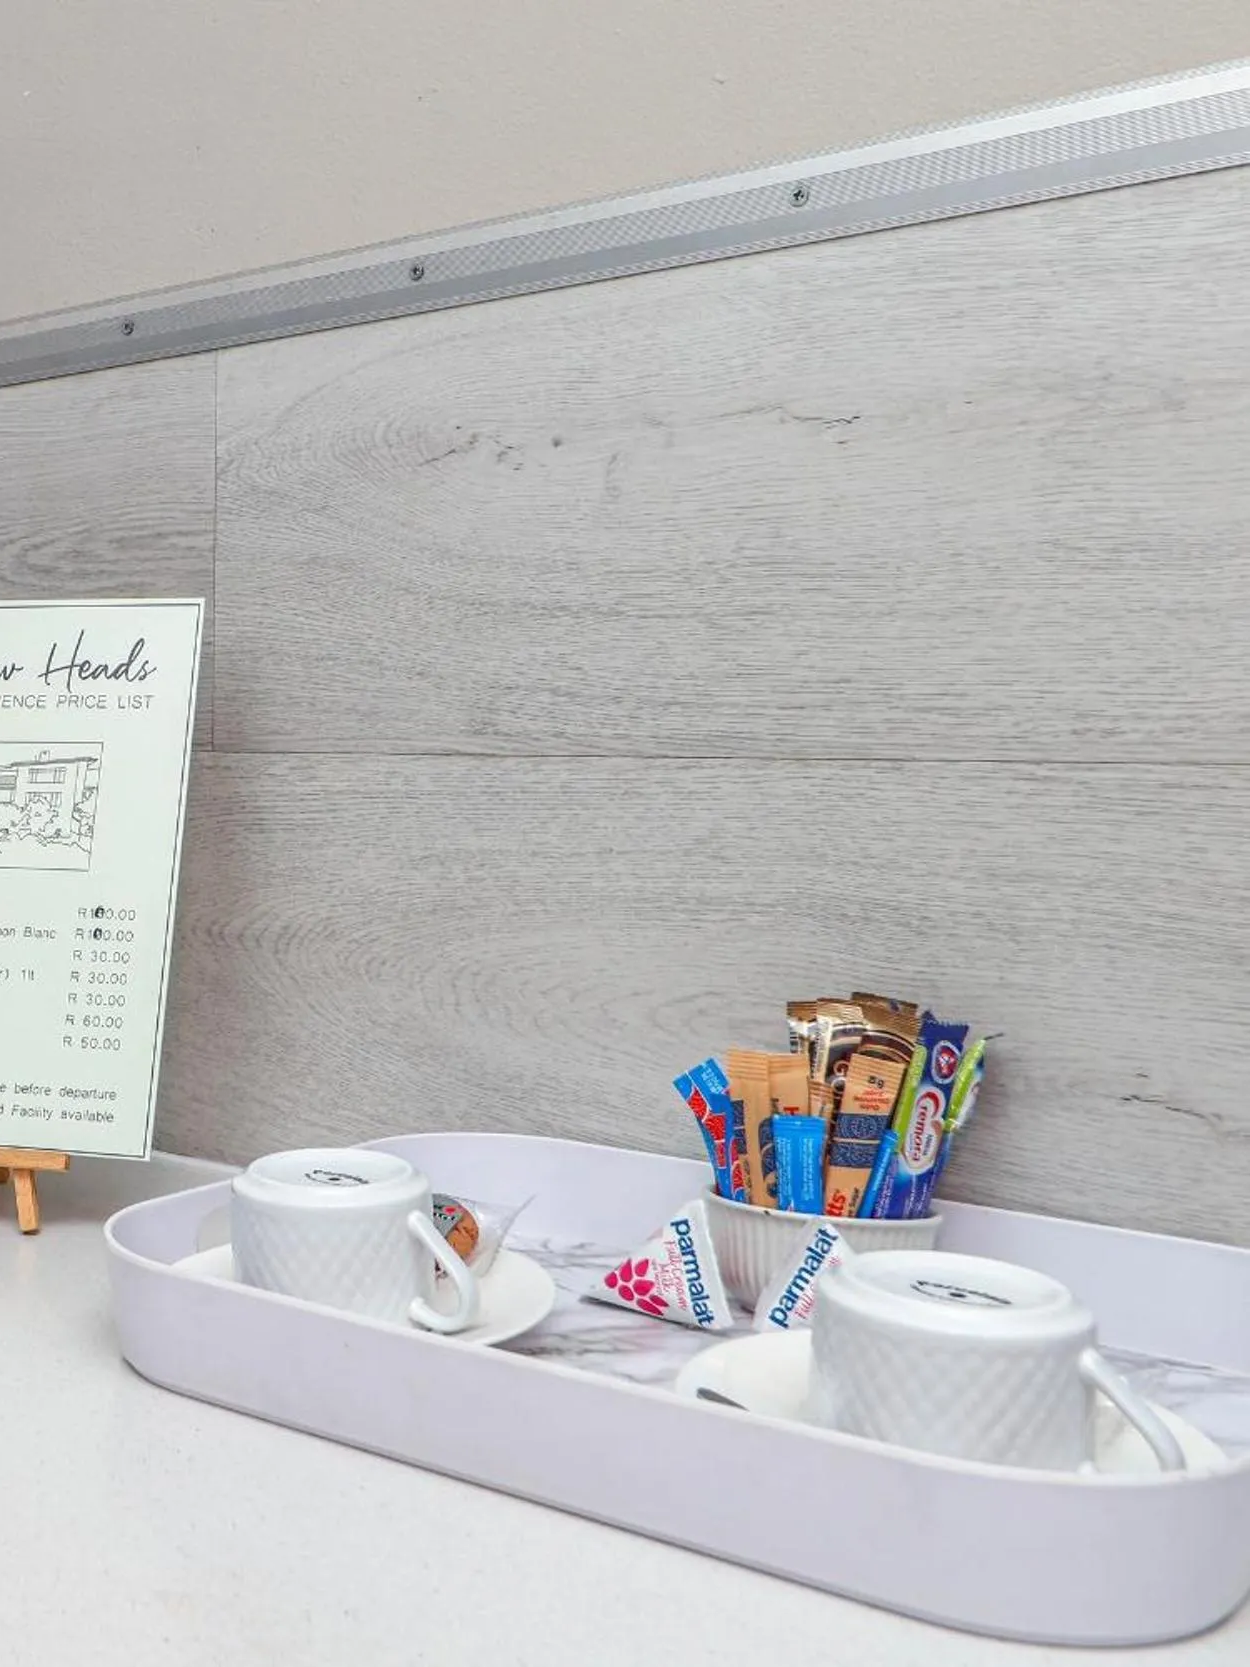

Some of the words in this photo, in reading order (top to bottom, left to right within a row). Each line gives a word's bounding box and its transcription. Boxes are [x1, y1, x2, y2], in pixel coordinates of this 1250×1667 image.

[39, 629, 157, 693] Heads
[55, 694, 107, 710] PRICE
[117, 694, 155, 710] LIST
[23, 926, 57, 939] Blanc
[90, 950, 130, 964] 30.00
[87, 971, 127, 985] 30.00
[14, 1082, 52, 1096] before
[58, 1086, 117, 1101] departure
[11, 1104, 53, 1121] Facility
[59, 1109, 114, 1124] available
[670, 1218, 715, 1327] parmalat
[768, 1228, 838, 1329] parmalat
